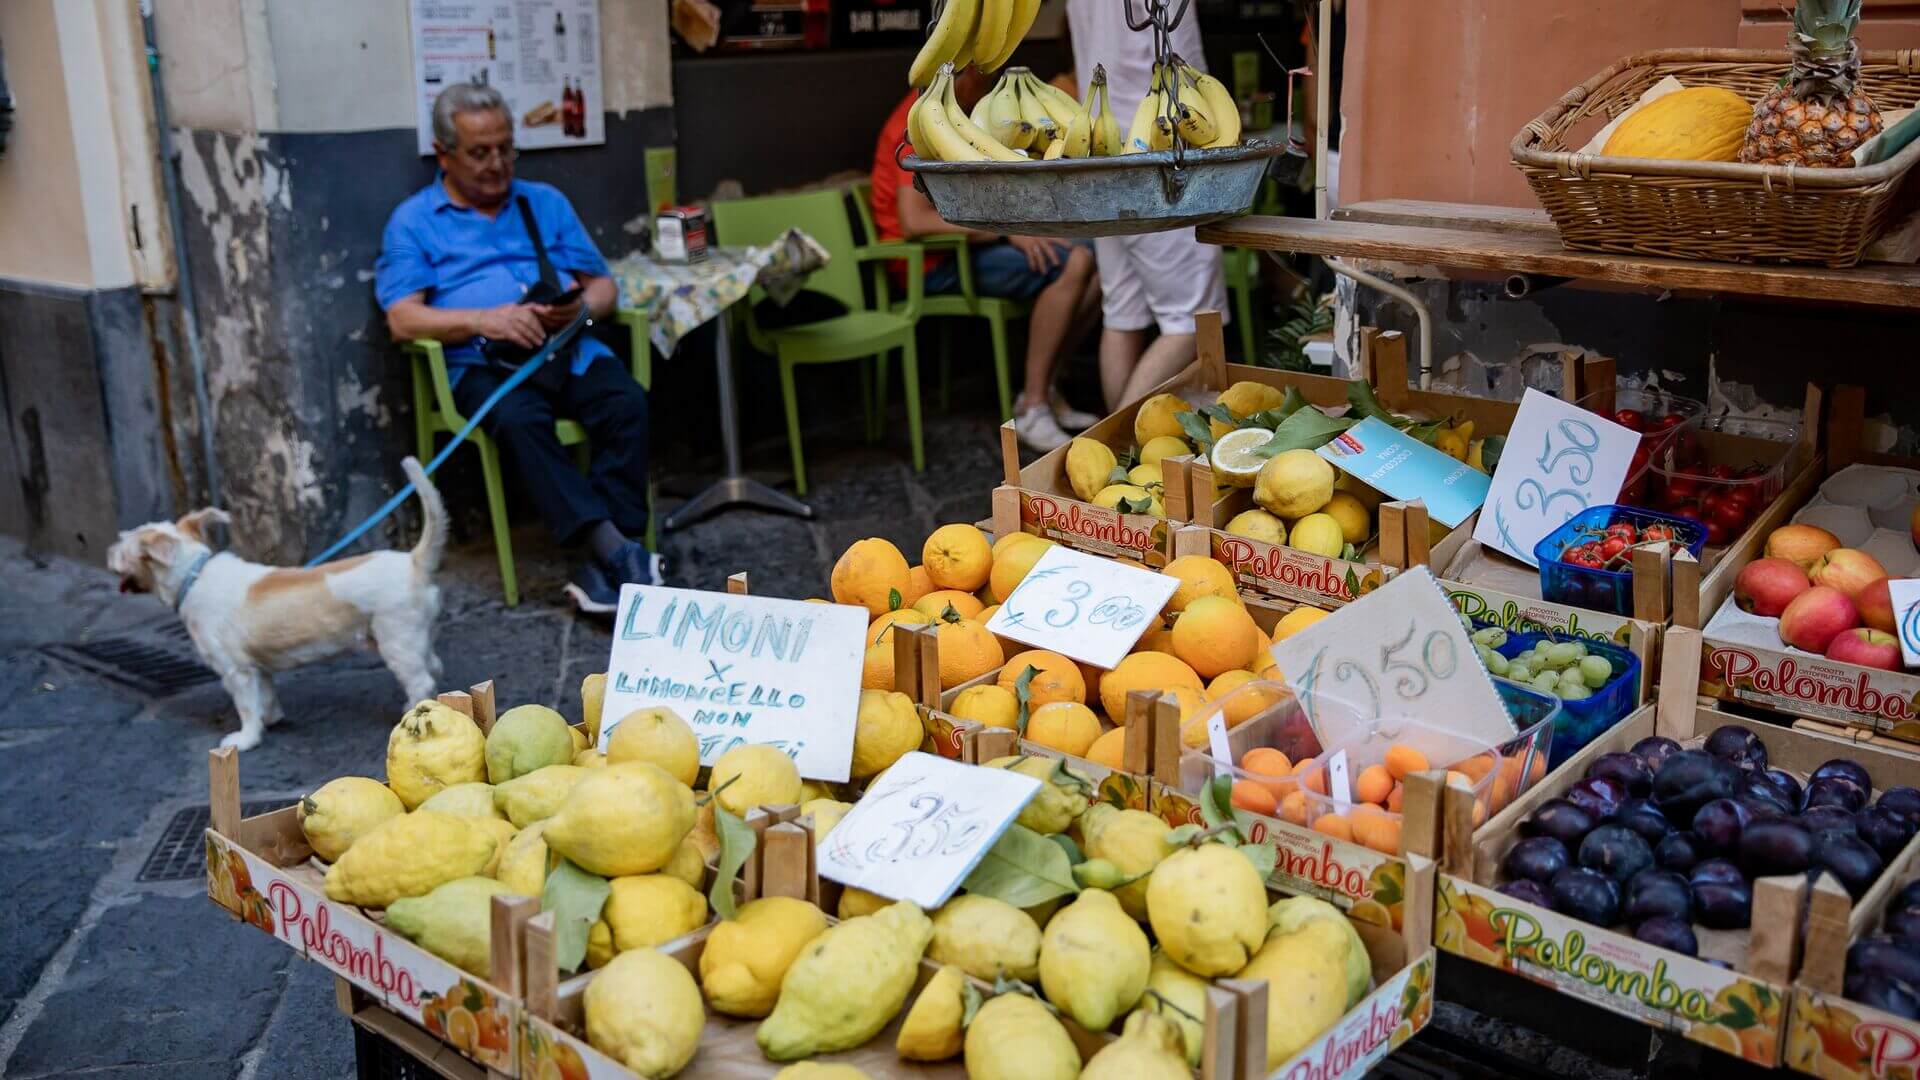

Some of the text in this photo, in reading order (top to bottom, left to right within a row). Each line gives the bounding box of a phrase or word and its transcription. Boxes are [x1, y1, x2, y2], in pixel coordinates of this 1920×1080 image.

[1029, 496, 1155, 550] Palomba
[621, 591, 813, 663] LIMONI
[693, 709, 752, 727] NON
[1710, 647, 1915, 720] Palomba
[267, 878, 422, 1008] Palomba
[1488, 906, 1719, 1025] Palomba
